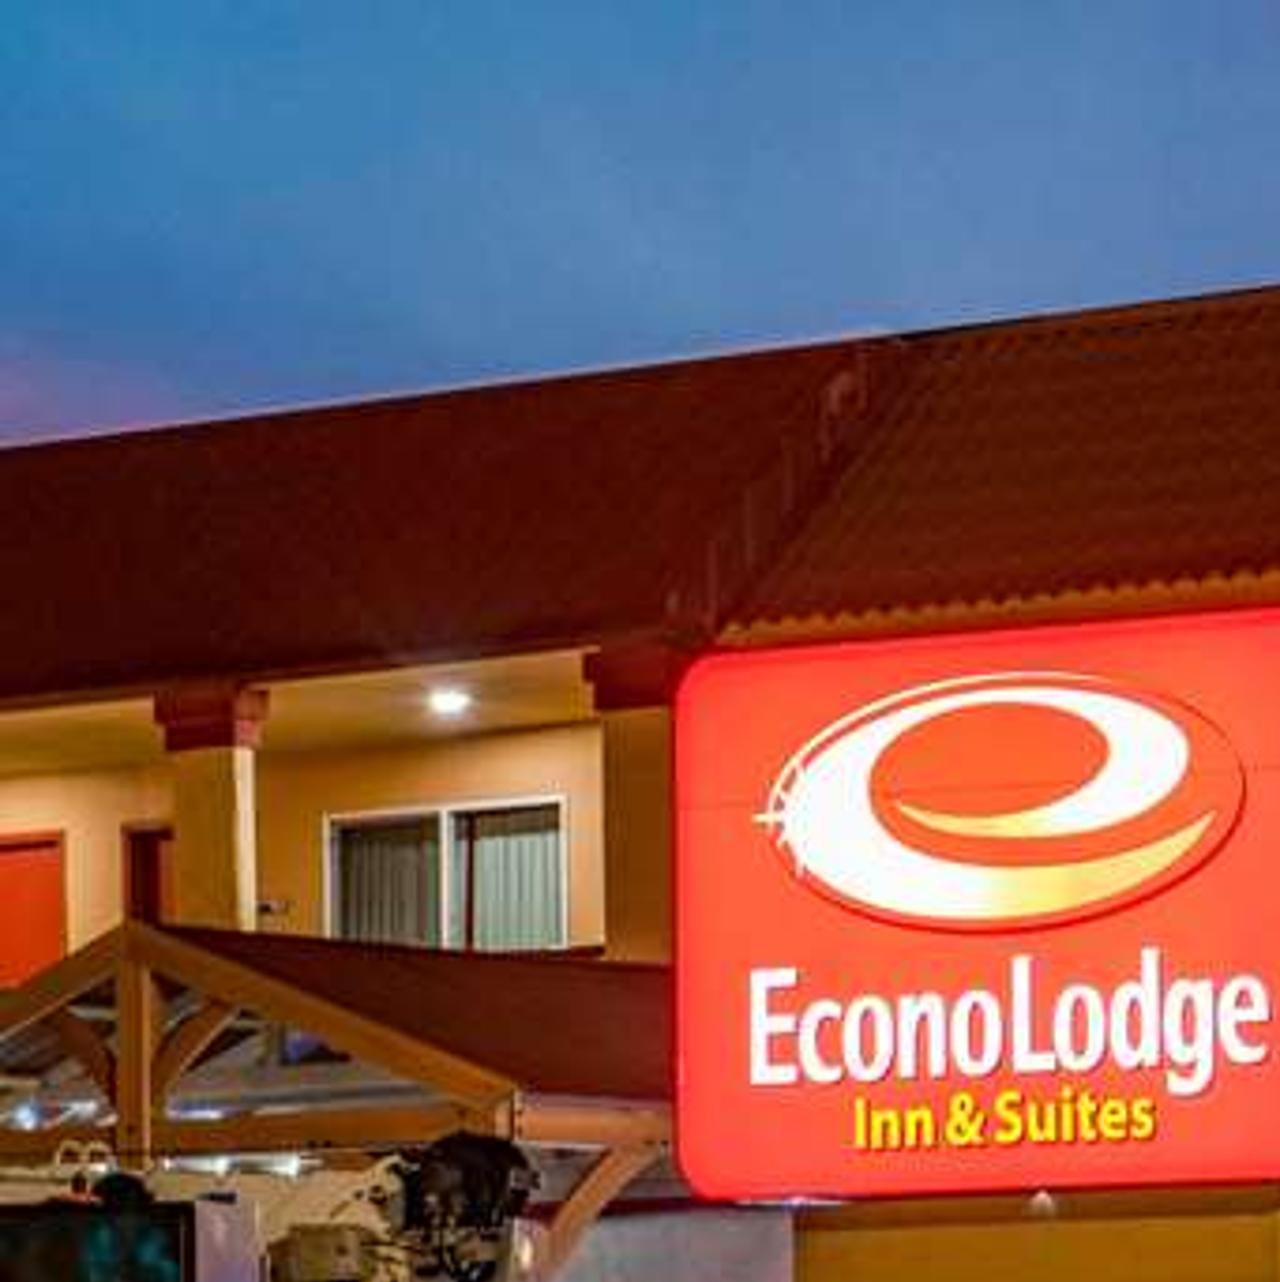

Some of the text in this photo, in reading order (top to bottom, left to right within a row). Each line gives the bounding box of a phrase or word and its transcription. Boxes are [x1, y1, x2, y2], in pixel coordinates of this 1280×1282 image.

[853, 1086, 1155, 1149] Inn & Suites
